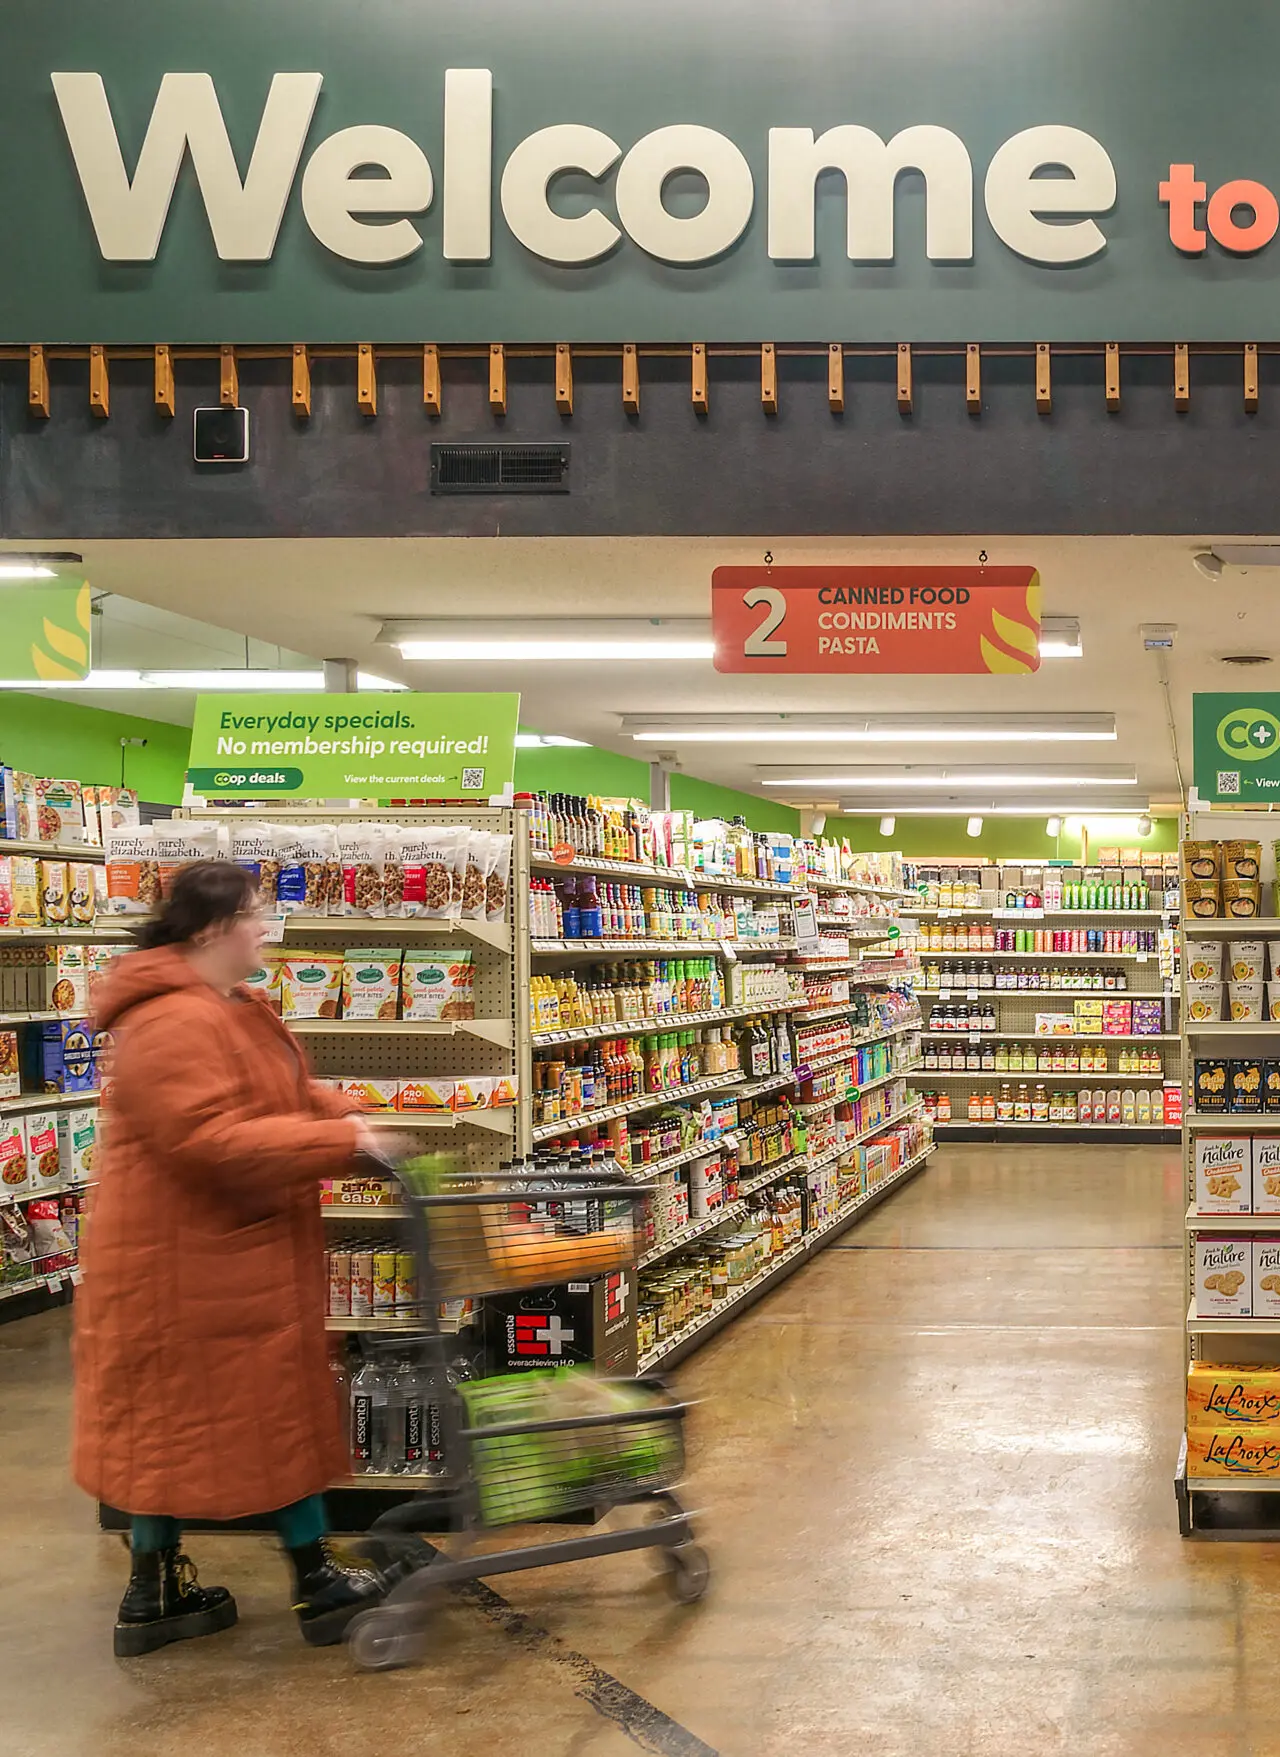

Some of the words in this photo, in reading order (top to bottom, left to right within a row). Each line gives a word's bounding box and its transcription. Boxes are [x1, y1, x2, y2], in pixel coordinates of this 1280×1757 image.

[50, 67, 1118, 264] Welcome
[1158, 163, 1280, 254] to
[818, 587, 903, 605] CANNED
[909, 587, 971, 605] FOOD
[743, 586, 788, 657] 2
[818, 612, 957, 630] CONDIMENTS
[818, 637, 880, 655] PASTA
[220, 711, 320, 733] Everyday
[324, 710, 416, 732] specials.
[217, 737, 246, 755] No
[250, 736, 383, 758] membership
[390, 736, 489, 758] required!
[344, 774, 367, 783] View
[369, 774, 384, 783] the
[386, 775, 417, 783] current
[419, 774, 446, 783] deals
[1255, 777, 1279, 788] View
[110, 838, 145, 849] purely
[232, 838, 265, 849] purely
[402, 841, 429, 853] purely
[400, 851, 446, 861] elizabeth.
[1202, 1147, 1244, 1164] nature
[341, 1194, 382, 1206] easy
[1203, 1250, 1245, 1267] nature
[505, 1314, 515, 1354] essentia
[508, 1359, 558, 1368] overachieving
[356, 1398, 367, 1444] essentia
